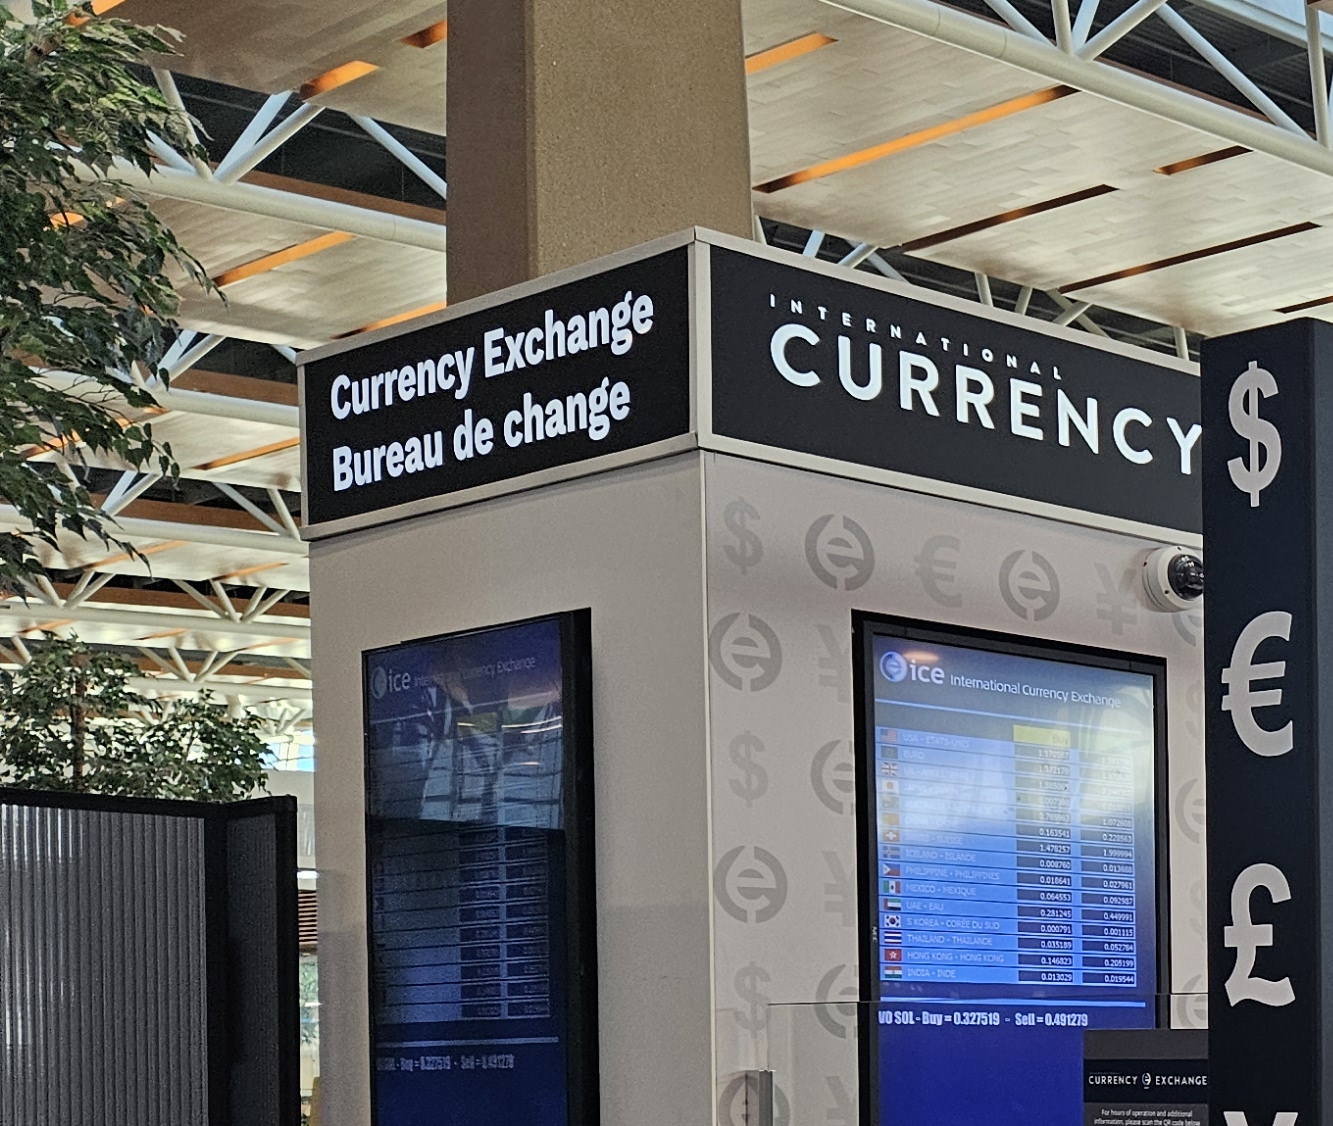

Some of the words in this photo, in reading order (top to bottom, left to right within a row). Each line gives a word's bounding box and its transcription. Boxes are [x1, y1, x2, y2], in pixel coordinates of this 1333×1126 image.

[770, 293, 1062, 380] INTERNATIONAL
[331, 347, 475, 419] Currency
[483, 290, 654, 378] Exchange
[770, 323, 1202, 475] CURRENCY
[333, 430, 443, 492] Bureau
[453, 408, 494, 461] de
[503, 376, 631, 448] change
[1228, 361, 1282, 507] $
[388, 669, 411, 693] ice
[910, 659, 945, 685] ice
[950, 674, 1020, 695] International
[1022, 685, 1069, 703] Currency
[1071, 691, 1121, 709] Exchange
[1221, 611, 1294, 757] €
[905, 883, 936, 893] MEXICO
[943, 885, 976, 896] MEXIQUE
[906, 901, 922, 910] UAE
[906, 918, 912, 926] S
[913, 918, 939, 927] KOREA
[971, 921, 983, 929] DU
[984, 921, 1000, 930] SUD
[1224, 863, 1296, 1007] £
[907, 934, 945, 944] THAILAND
[952, 936, 993, 946] THAILANDE
[907, 951, 930, 960] HONG
[932, 952, 953, 961] KONG
[961, 953, 983, 962] HONG
[984, 954, 1004, 963] KONG
[907, 968, 930, 977] INDIA
[937, 969, 956, 978] INDE
[894, 1010, 915, 1025] SOL
[922, 1011, 943, 1026] Buy
[953, 1011, 1000, 1026] 0.327519
[1015, 1012, 1036, 1026] Sell
[1045, 1012, 1088, 1027] 0.491279
[1088, 1076, 1138, 1085] CURRENCY
[1155, 1076, 1208, 1086] EXCHANGE
